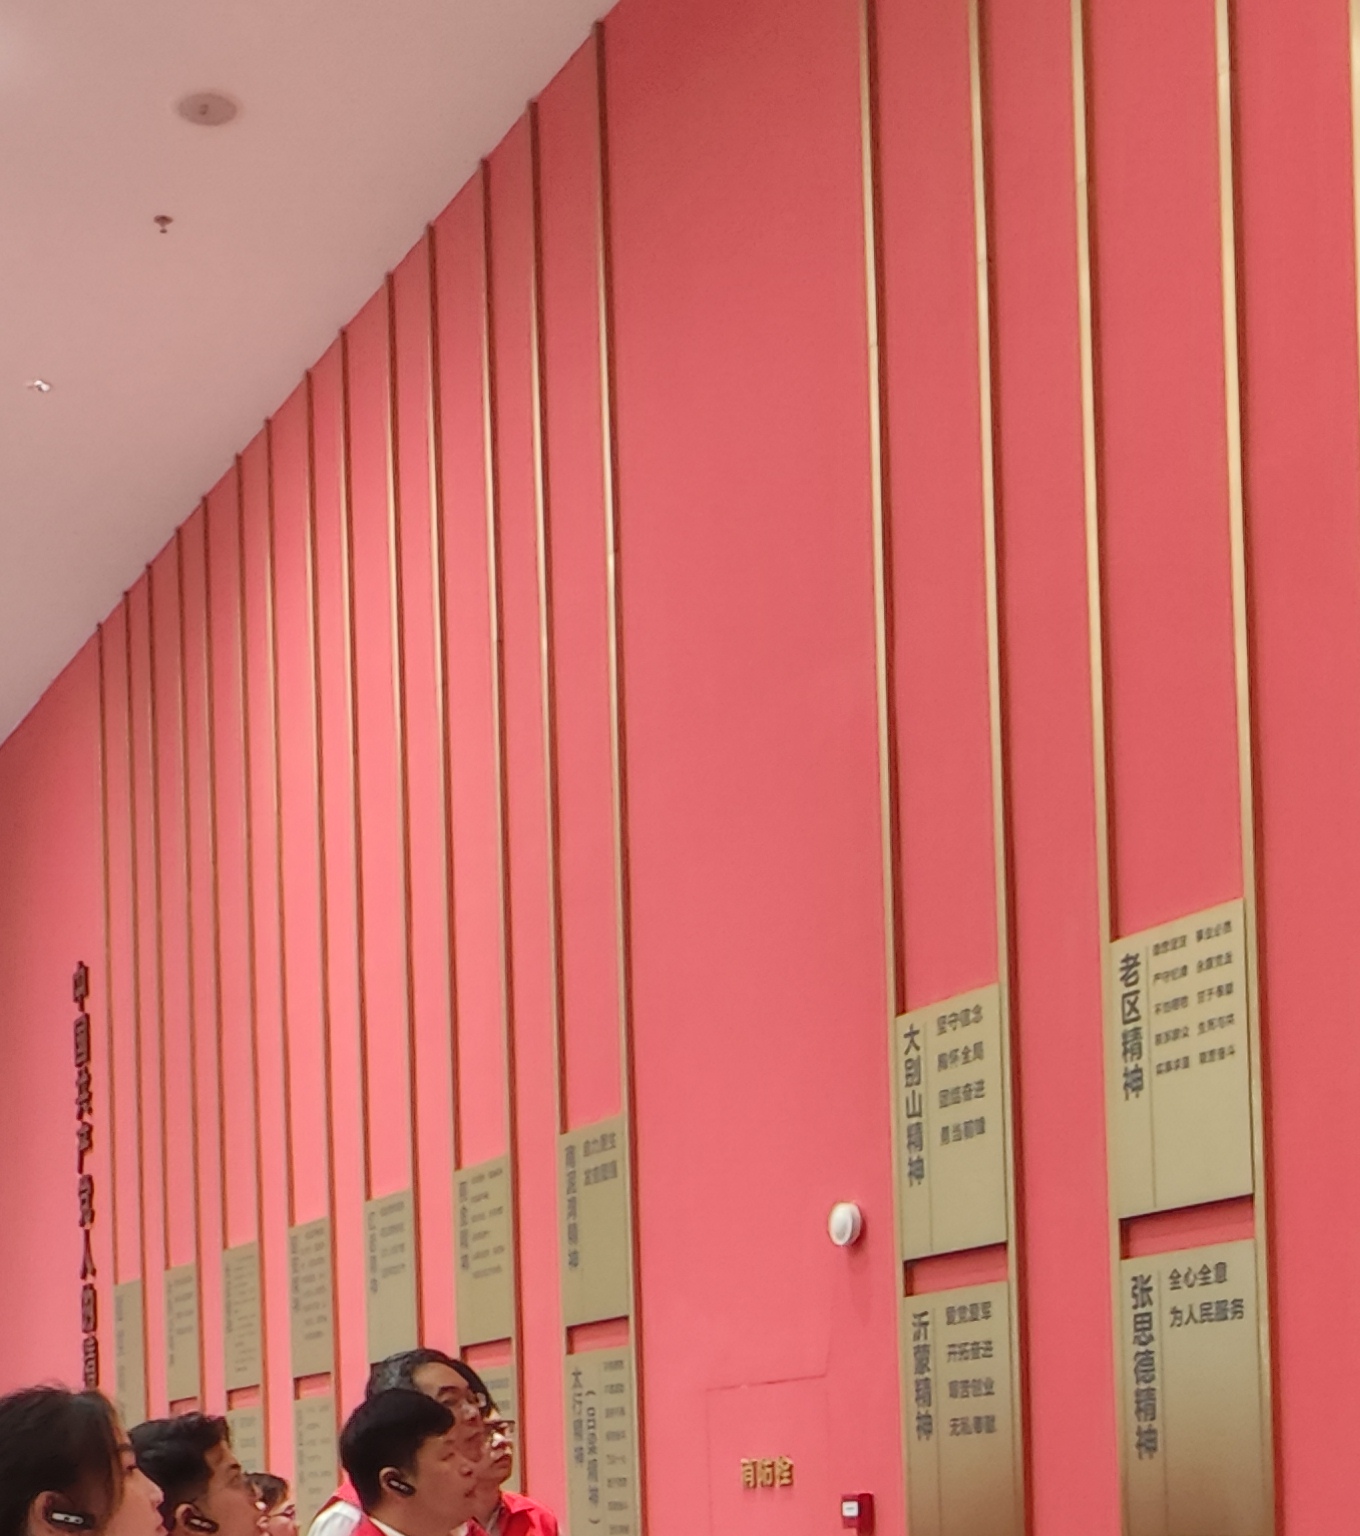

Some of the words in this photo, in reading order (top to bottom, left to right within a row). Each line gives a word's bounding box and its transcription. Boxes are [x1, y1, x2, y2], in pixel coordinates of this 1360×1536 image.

[903, 1022, 925, 1187] 大别山精神
[1119, 952, 1144, 1101] 老区精神
[1130, 1273, 1159, 1461] 张思德精神
[1169, 1298, 1245, 1327] 为人民服务
